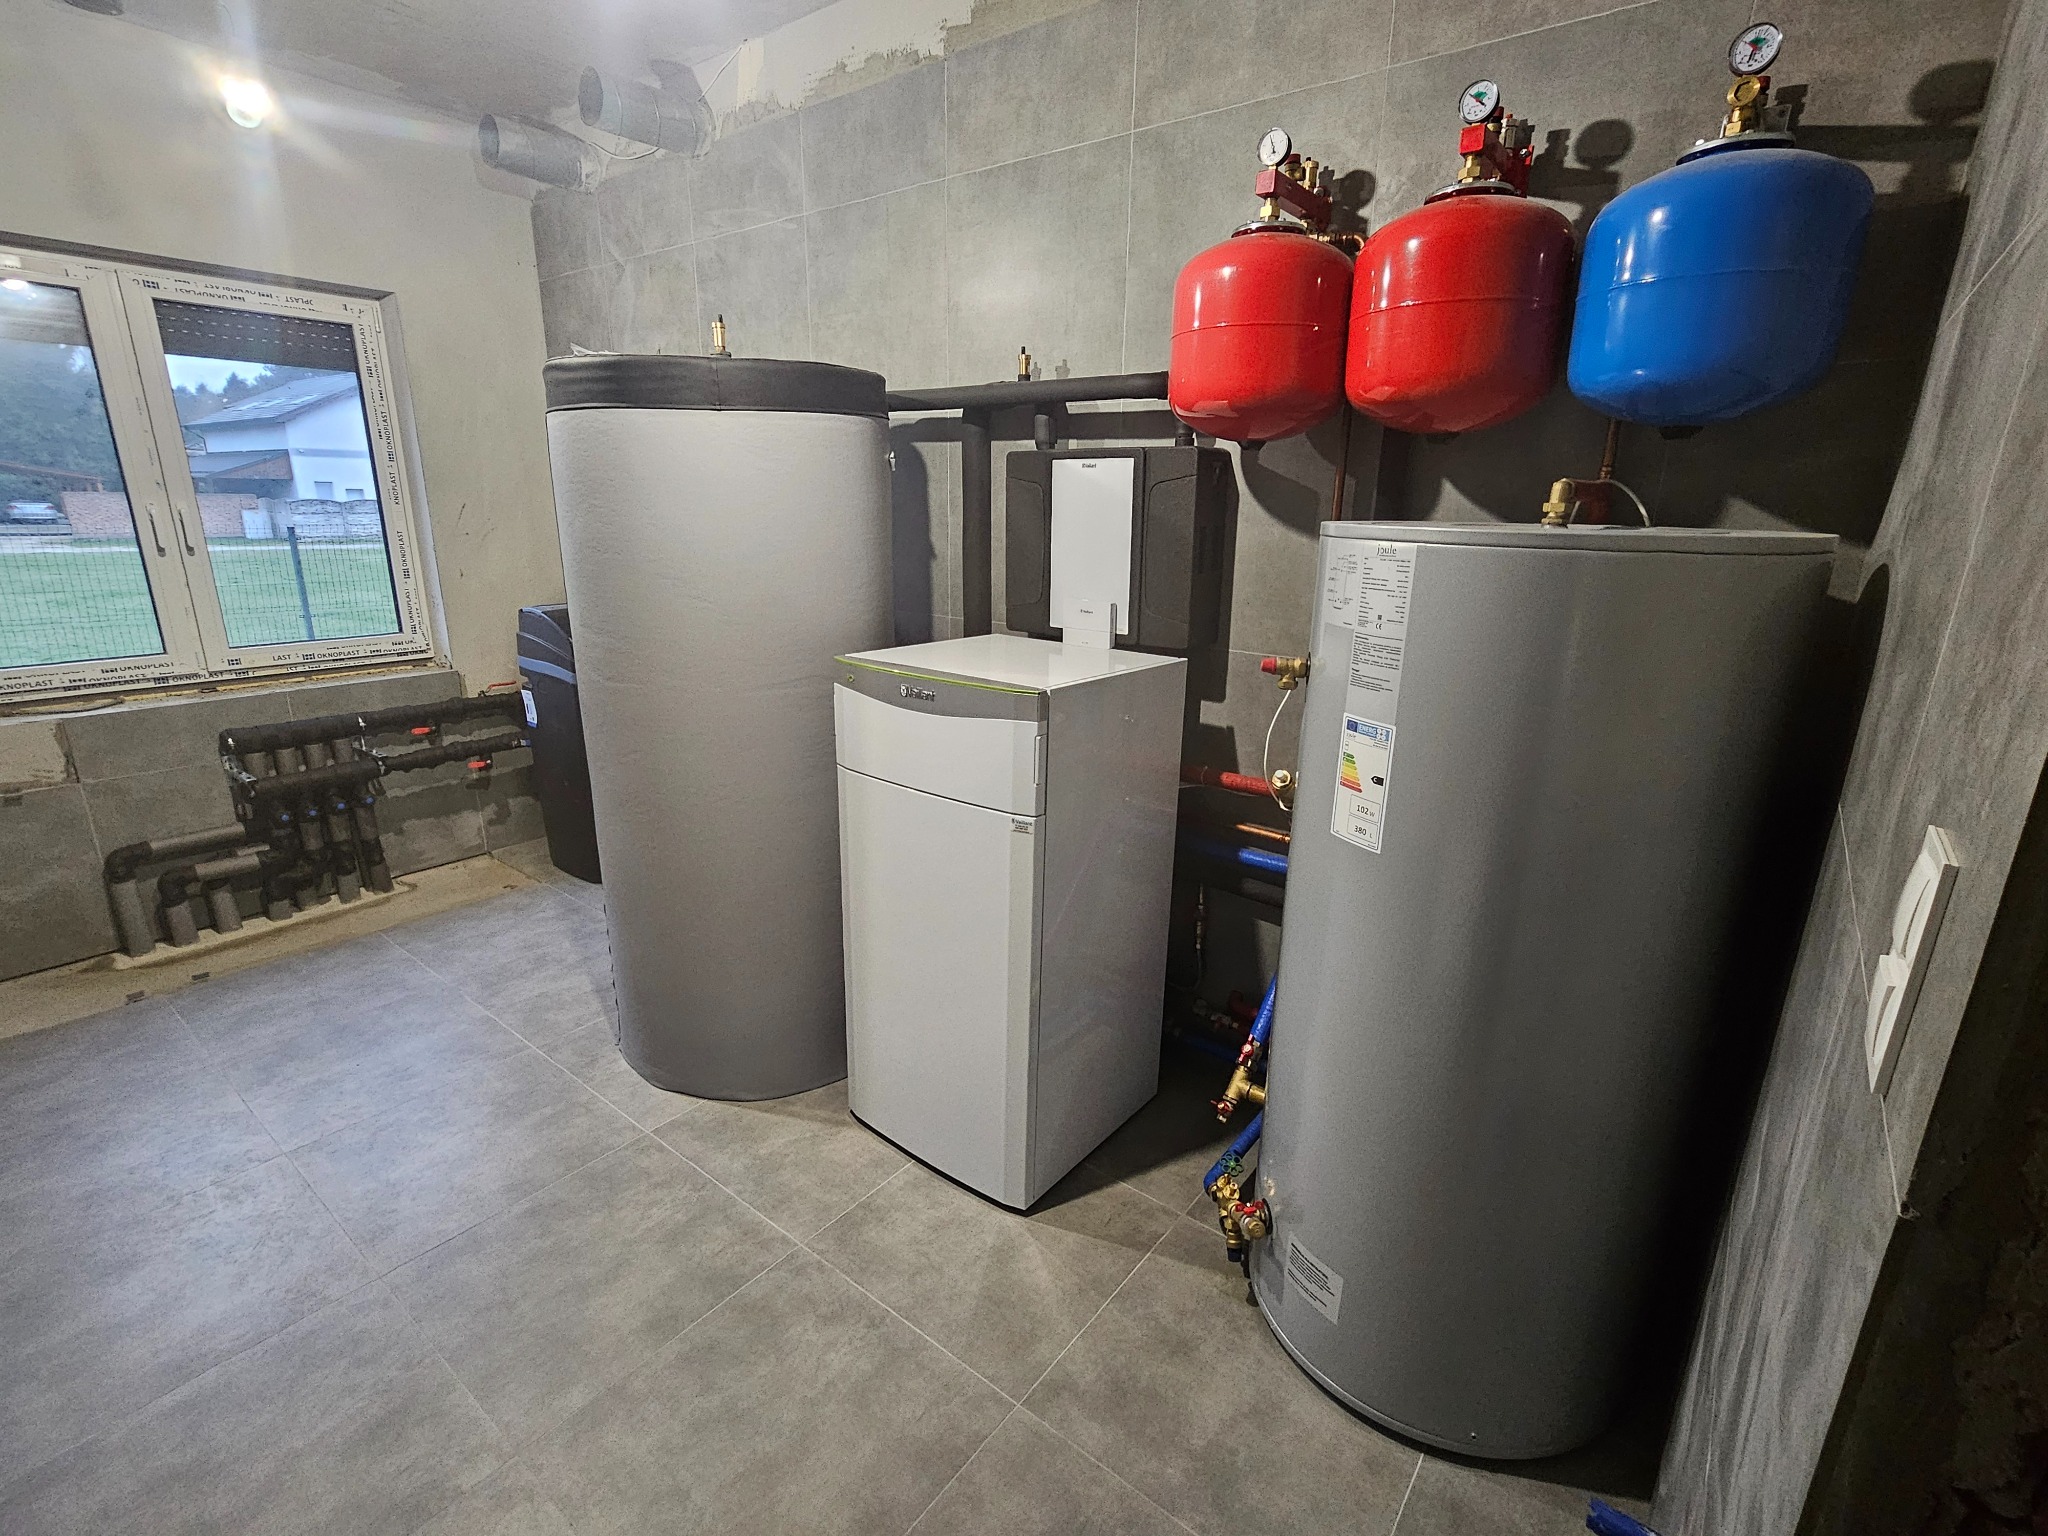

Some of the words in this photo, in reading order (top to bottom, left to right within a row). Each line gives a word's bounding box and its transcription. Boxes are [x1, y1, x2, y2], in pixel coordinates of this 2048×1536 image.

[380, 410, 394, 451] OKNOPLAST
[397, 531, 408, 567] OKNOPLAST
[1377, 544, 1397, 556] joule
[317, 649, 360, 659] OKNOPLAST
[172, 671, 224, 683] OKNOPLAST
[1357, 805, 1369, 816] 102
[1354, 825, 1367, 836] 380
